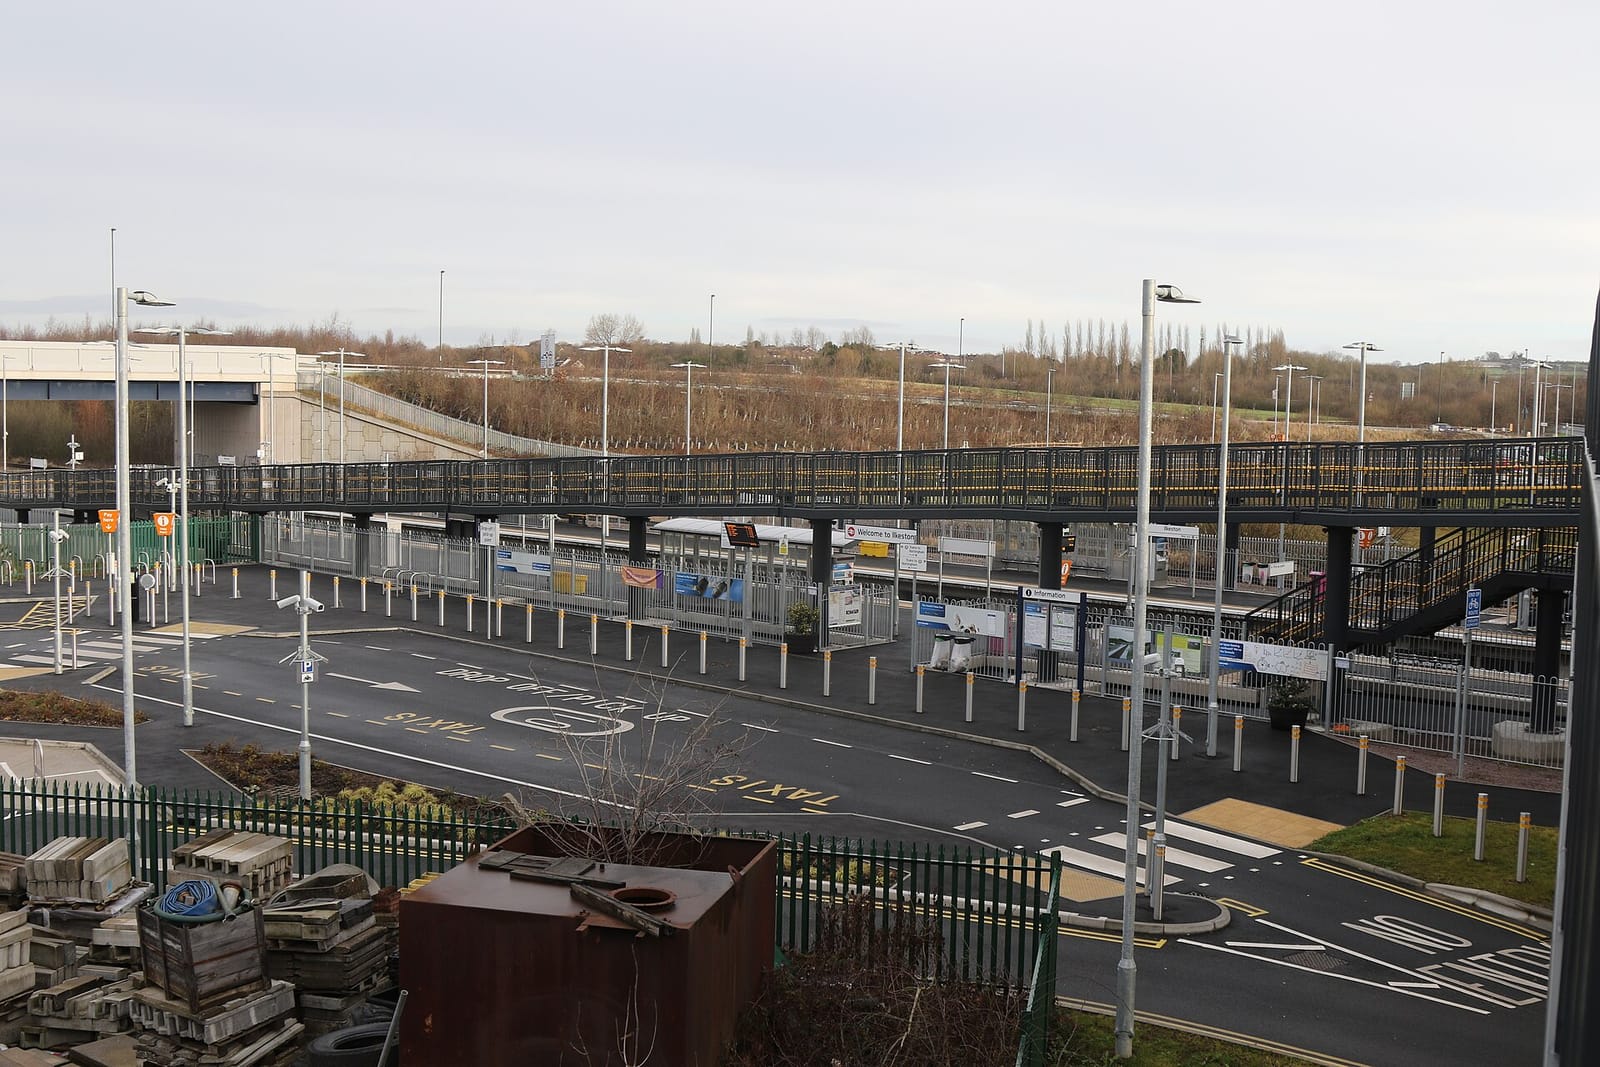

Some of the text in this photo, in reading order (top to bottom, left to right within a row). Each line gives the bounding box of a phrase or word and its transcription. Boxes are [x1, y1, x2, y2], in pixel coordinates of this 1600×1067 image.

[857, 528, 883, 538] Welcome
[892, 532, 915, 540] Ilkeston
[1034, 590, 1066, 599] Information
[304, 661, 311, 672] P
[436, 667, 511, 684] DROP
[643, 711, 691, 723] UP
[384, 712, 487, 735] TAXIS
[710, 774, 841, 806] TAXIS
[1340, 915, 1474, 955] NO
